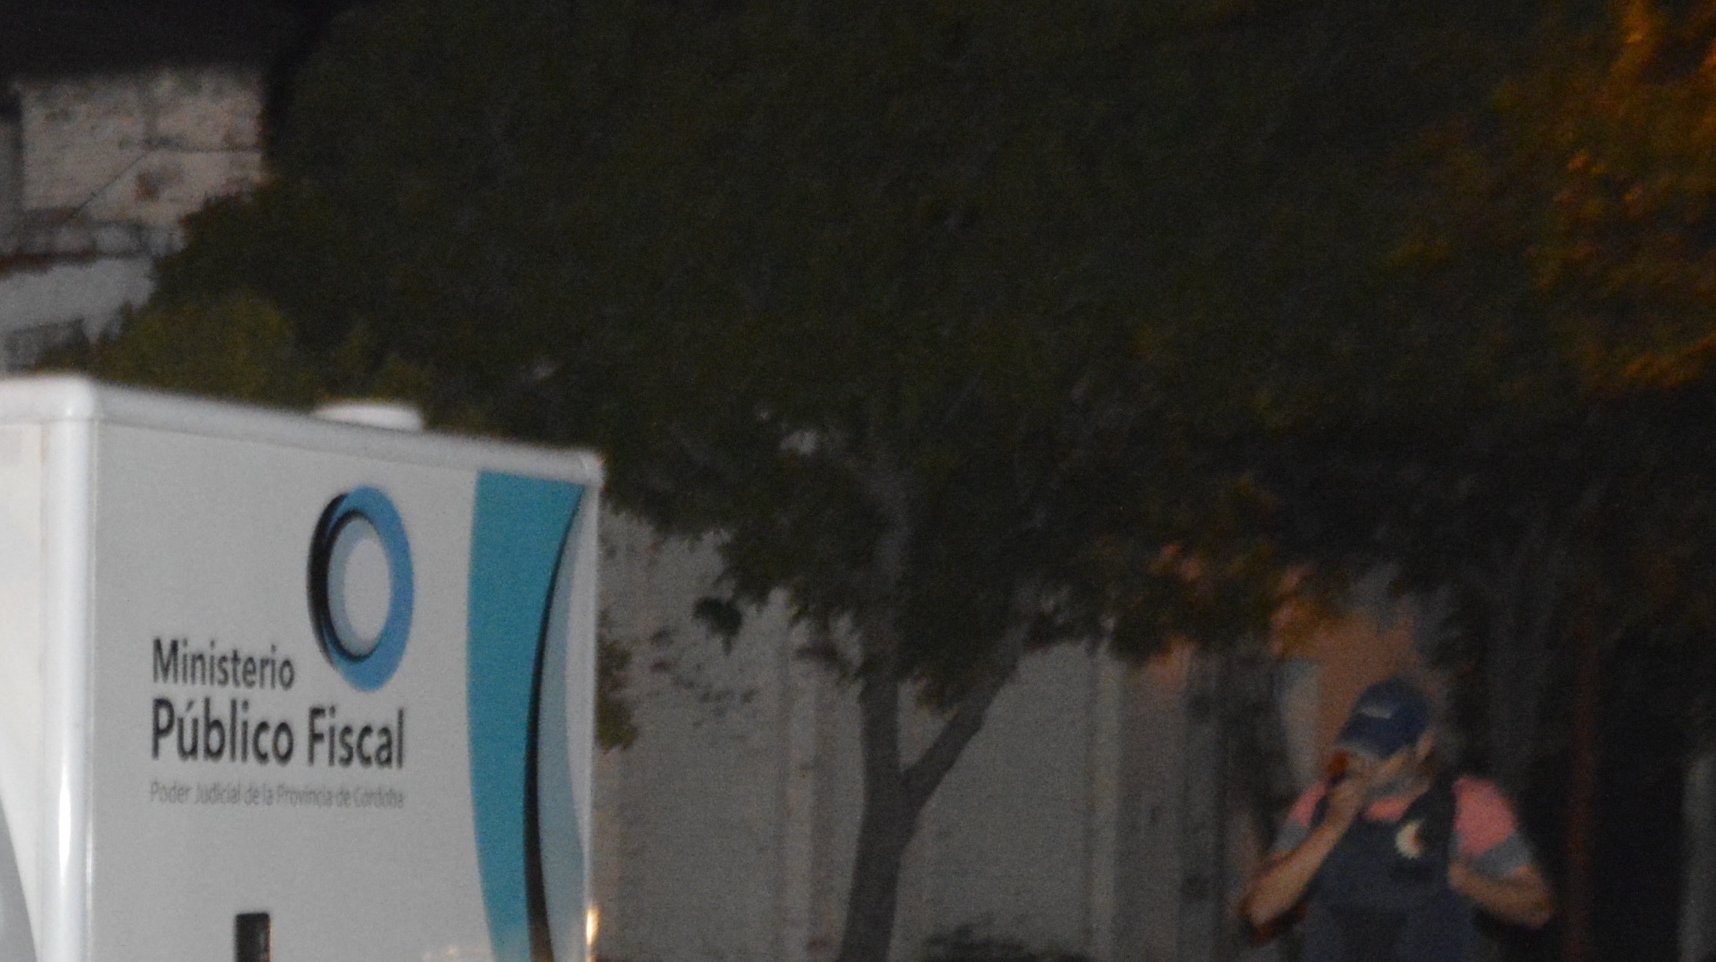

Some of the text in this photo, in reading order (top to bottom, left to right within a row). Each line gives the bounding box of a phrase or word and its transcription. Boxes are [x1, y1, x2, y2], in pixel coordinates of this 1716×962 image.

[153, 638, 296, 689] Ministerio
[151, 697, 404, 769] Público Fiscal
